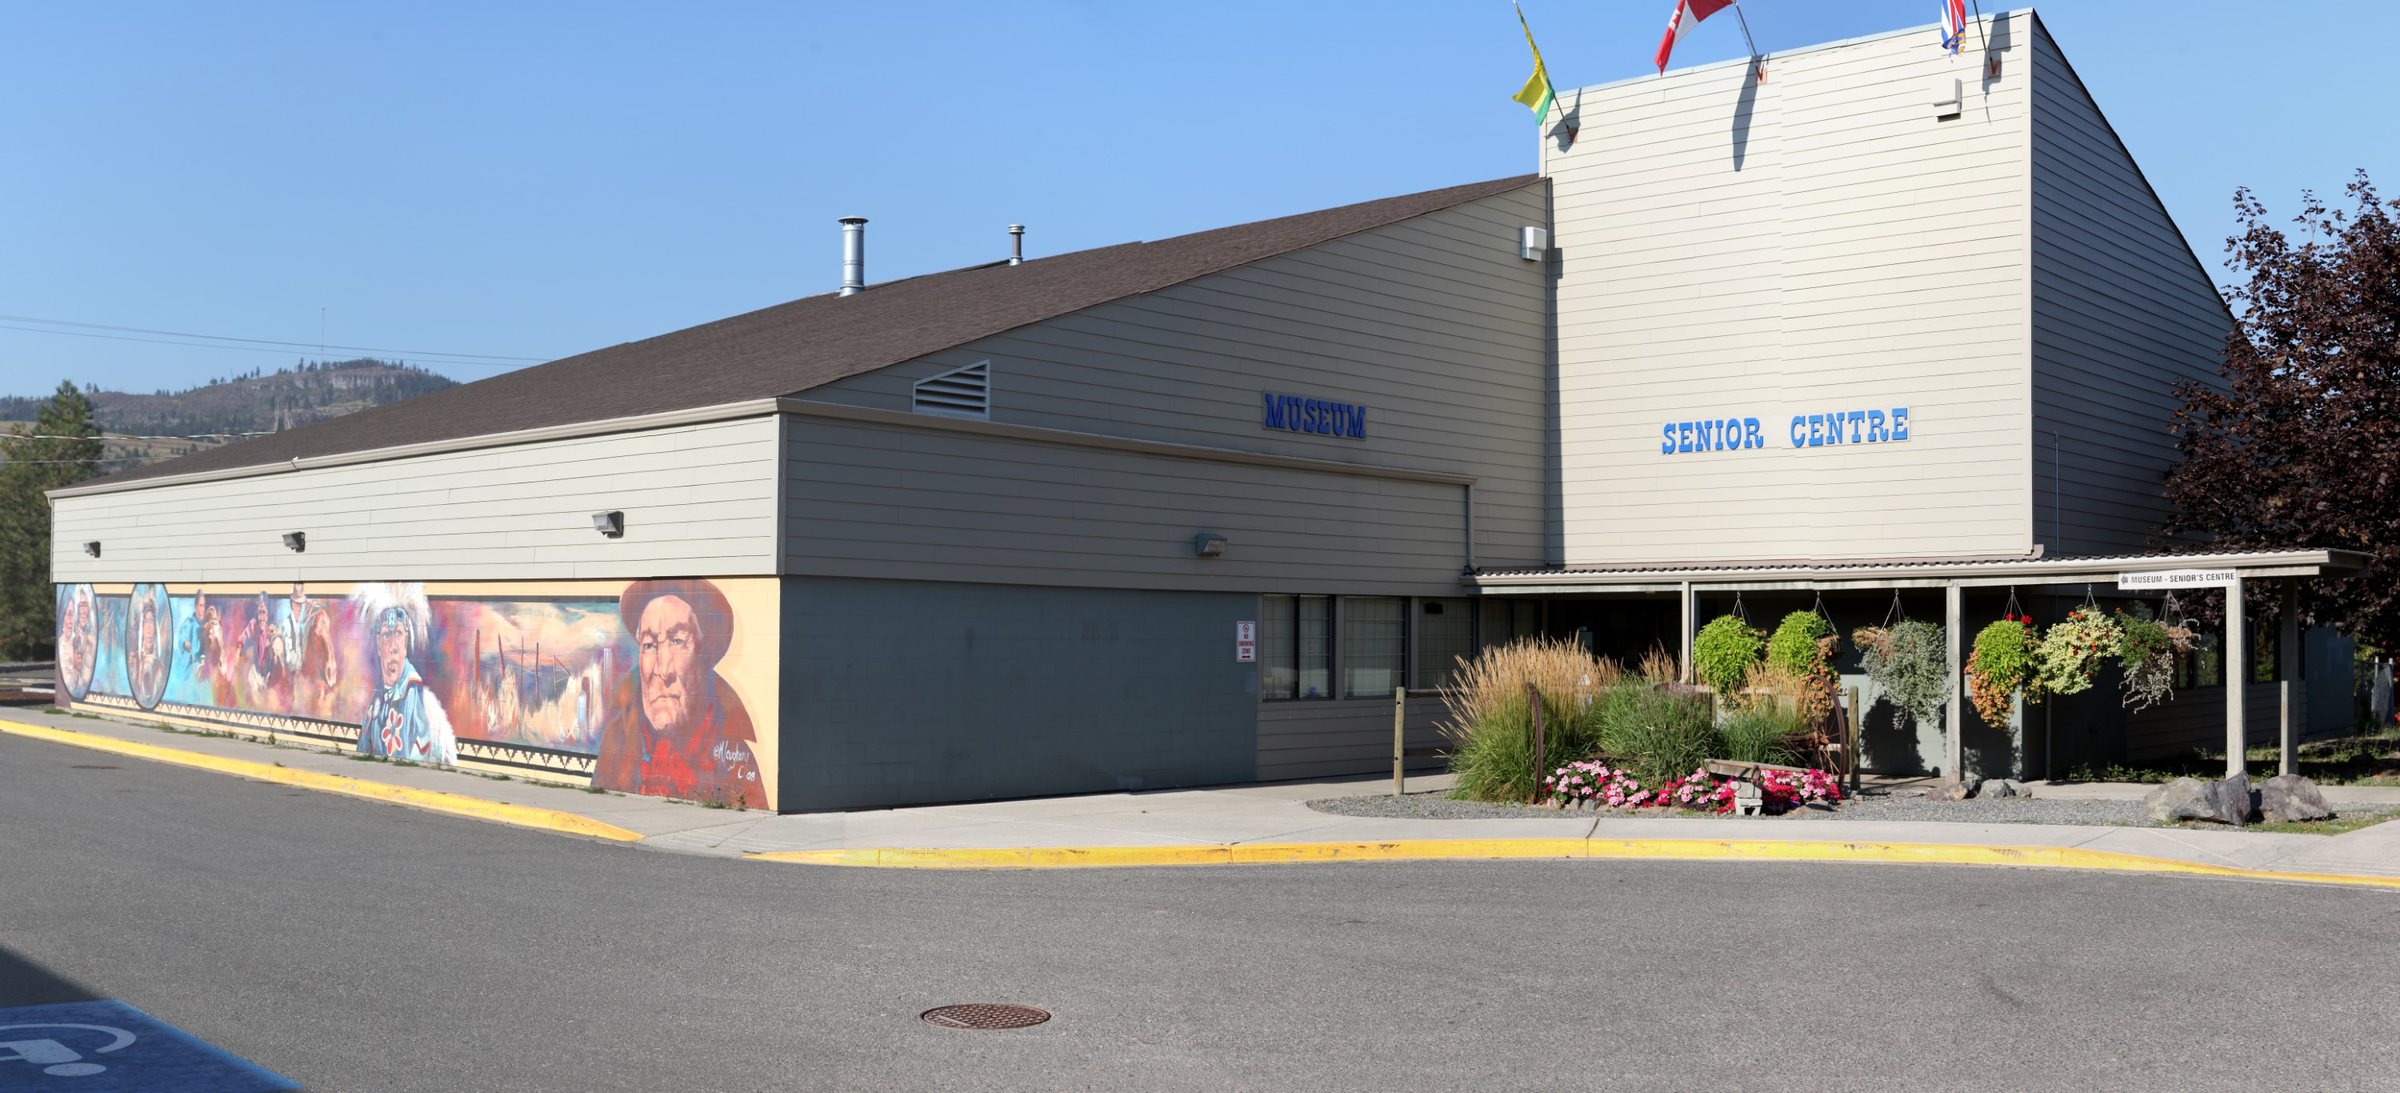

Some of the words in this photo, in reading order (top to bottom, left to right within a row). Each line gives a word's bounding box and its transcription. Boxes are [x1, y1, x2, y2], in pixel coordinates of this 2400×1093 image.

[1265, 393, 1367, 438] MUSEUM
[1661, 418, 1764, 455] SENIOR
[1790, 407, 1908, 448] CENTRE
[2131, 575, 2163, 583] MUSEUM
[2169, 574, 2204, 583] SENIOR'S
[2205, 572, 2235, 581] CENTRE
